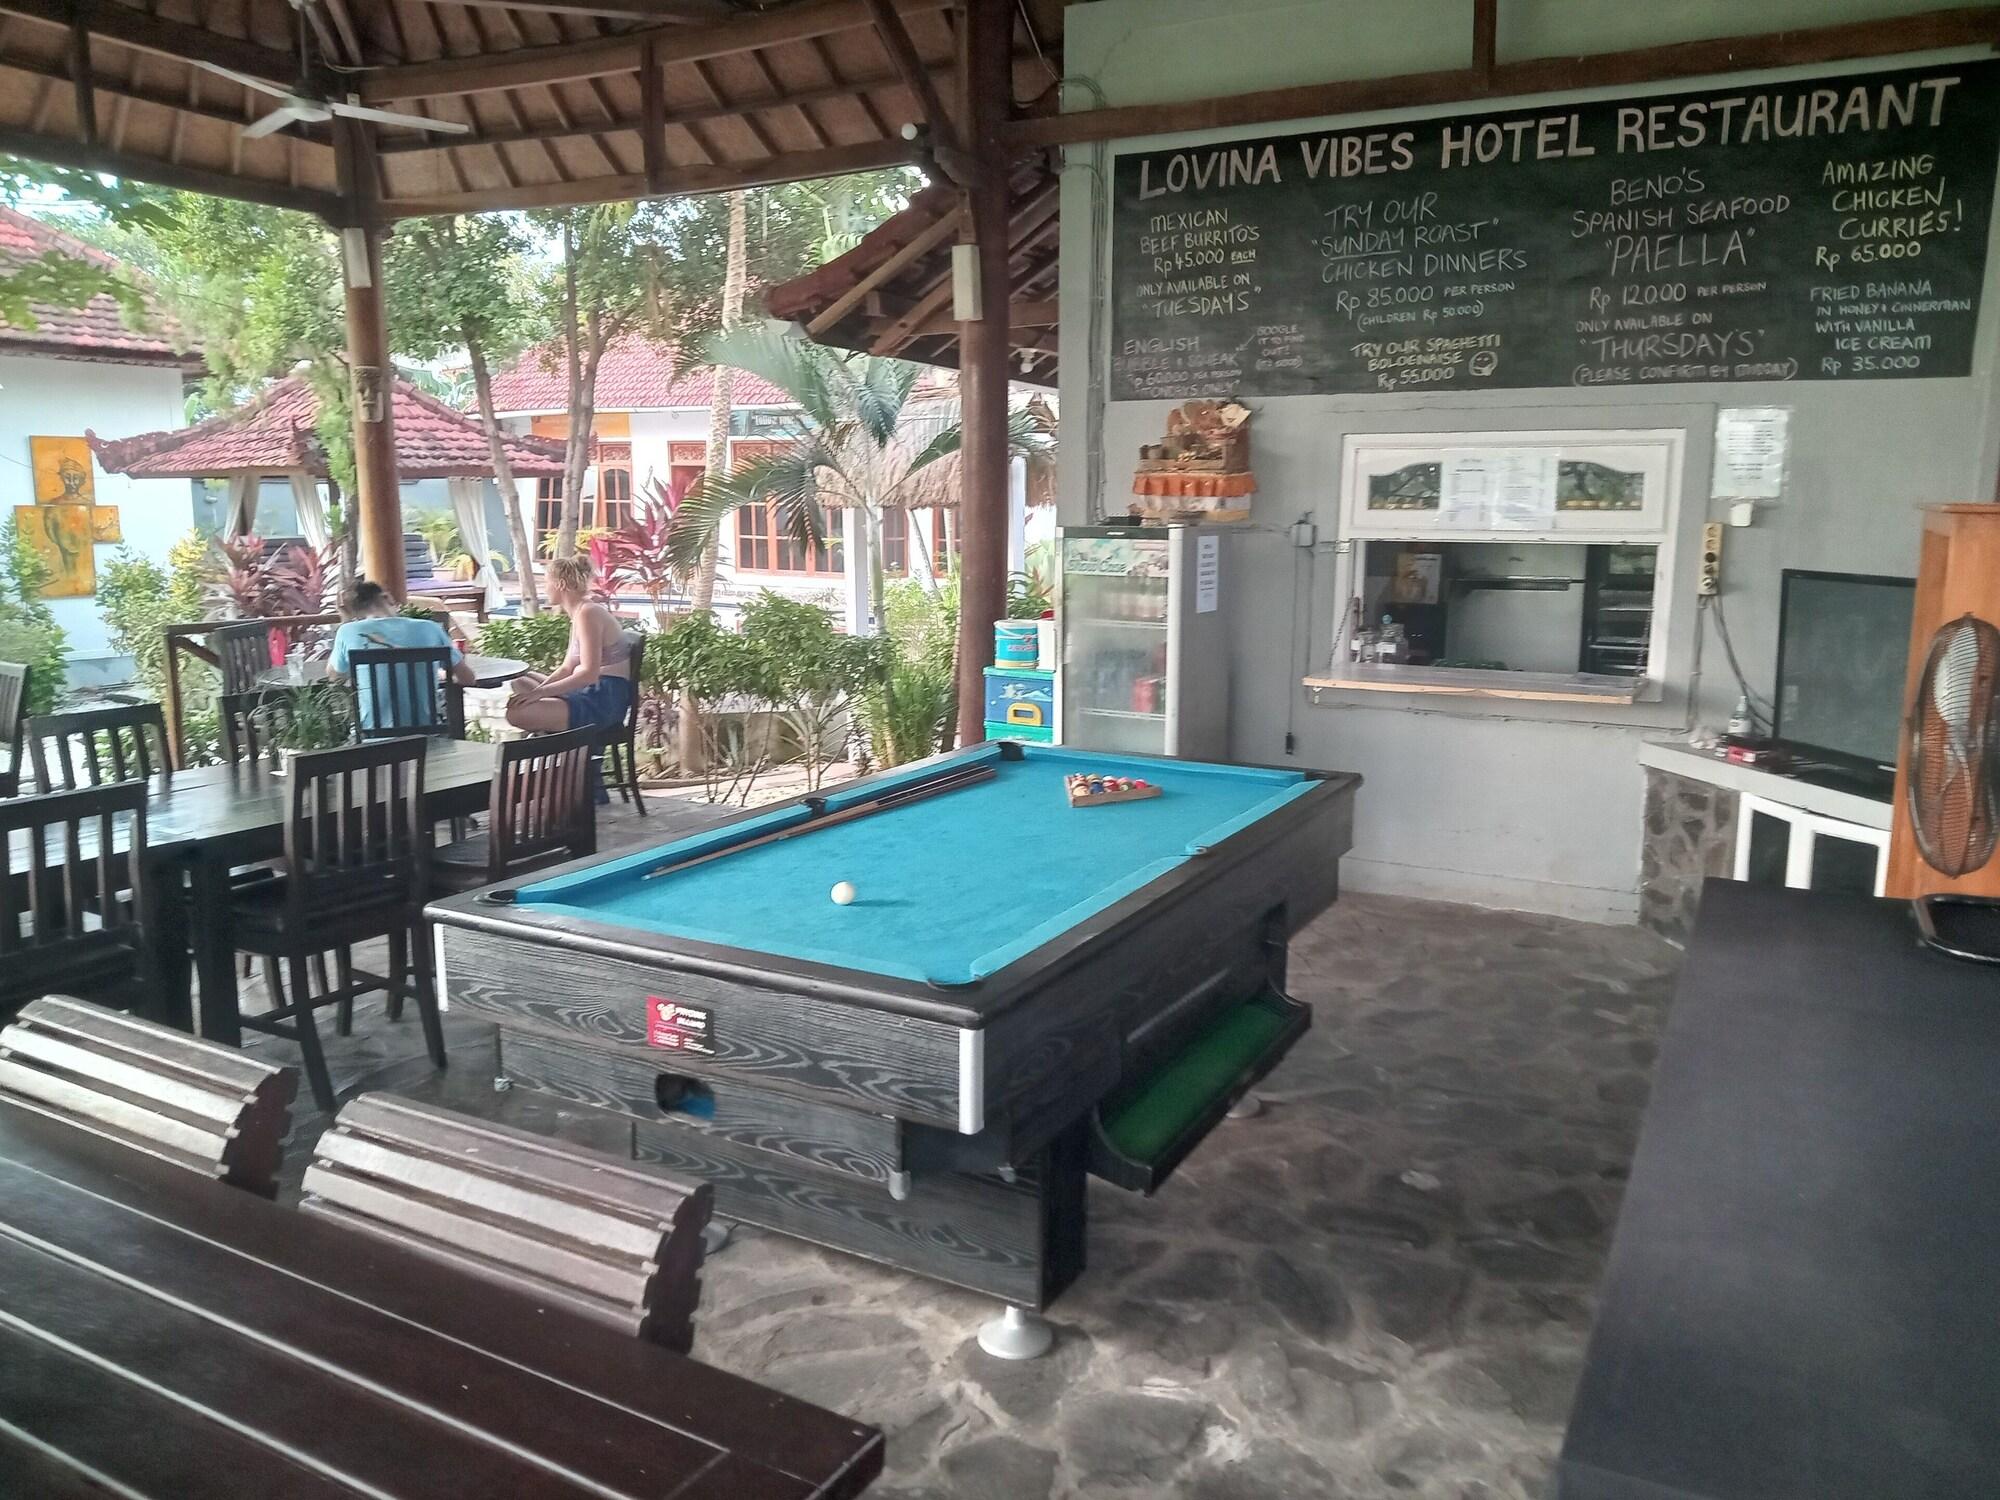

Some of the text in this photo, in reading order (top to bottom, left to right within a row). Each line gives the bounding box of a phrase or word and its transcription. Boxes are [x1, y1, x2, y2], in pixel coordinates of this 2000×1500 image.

[1139, 77, 1961, 200] LOVINA VIBES HOTEL RESTAURANT
[1822, 154, 1935, 185] AMAZING
[1610, 167, 1705, 206] BENO'S
[1832, 176, 1945, 212] CHICKEN
[1151, 208, 1228, 233] MEXICAN
[1324, 192, 1438, 232] TRY OUR
[1571, 194, 1790, 238] SPANISH SEAFOOD
[1839, 198, 1962, 240] CURRIES!
[1140, 234, 1180, 255] BEEF
[1816, 241, 1921, 273] Rp 65.000
[1154, 248, 1256, 279] Rp 45.000 EACH
[1322, 248, 1528, 283] CHICKEN DINNERS
[1136, 273, 1250, 298] ONLY AVAILABLE ON
[1587, 285, 1611, 314] Rp
[1697, 286, 1718, 297] PER
[1721, 282, 1767, 294] PERSON
[1809, 279, 1932, 301] FRIED BANANA
[1336, 281, 1516, 320] Rp 85.000 PER PERSON
[1816, 306, 1831, 316] IN
[1839, 303, 1878, 315] HONEY
[1256, 324, 1298, 337] GOOGLE
[1423, 309, 1437, 327] Rp
[1575, 312, 1713, 333] ONLY AVAILABLE ON
[1816, 317, 1916, 334] WITH VANILLA
[1123, 336, 1200, 356] ENGLISH
[1351, 334, 1500, 358] TRY OUR SPAGHETTI
[1836, 334, 1932, 351] ICE CREAM
[1709, 365, 1729, 378] BY
[1821, 355, 1921, 376] Rp 35.000
[1377, 372, 1398, 391] Rp
